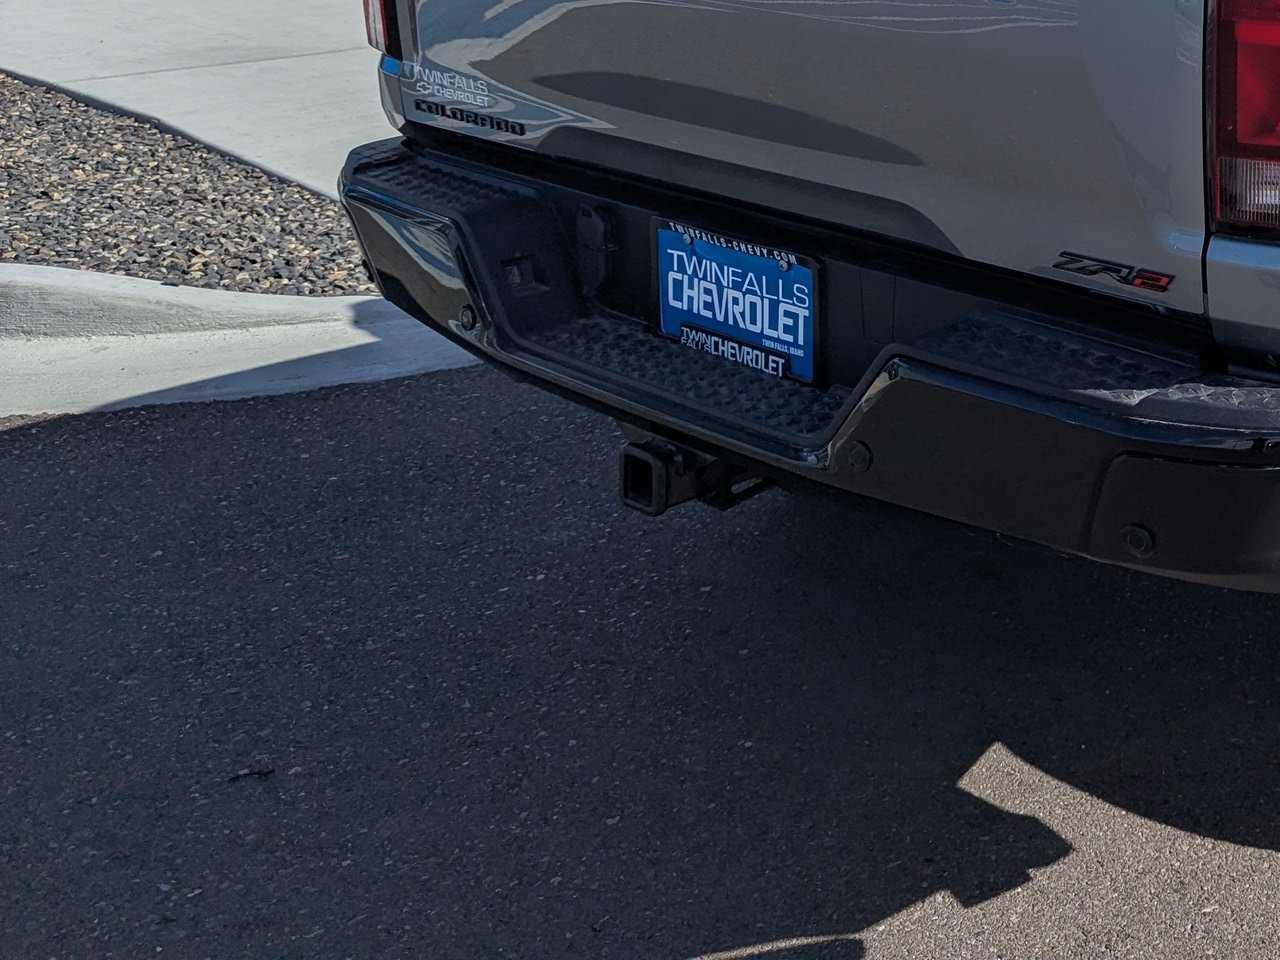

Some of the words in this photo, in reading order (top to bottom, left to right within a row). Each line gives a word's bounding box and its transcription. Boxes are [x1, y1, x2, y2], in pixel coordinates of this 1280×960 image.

[415, 64, 489, 96] TWINFALLS
[434, 86, 489, 108] CHEVROLET
[414, 98, 526, 136] COLORADO
[669, 222, 798, 265] TWINFALLS-CHEVY.COM
[667, 249, 809, 309] TWINFALLS
[1052, 250, 1176, 293] ZR2
[668, 271, 810, 346] CHEVROLET
[680, 337, 711, 354] FALLS
[681, 326, 711, 346] TWIN
[789, 346, 805, 357] IDAHO
[710, 335, 785, 377] CHEVROLET
